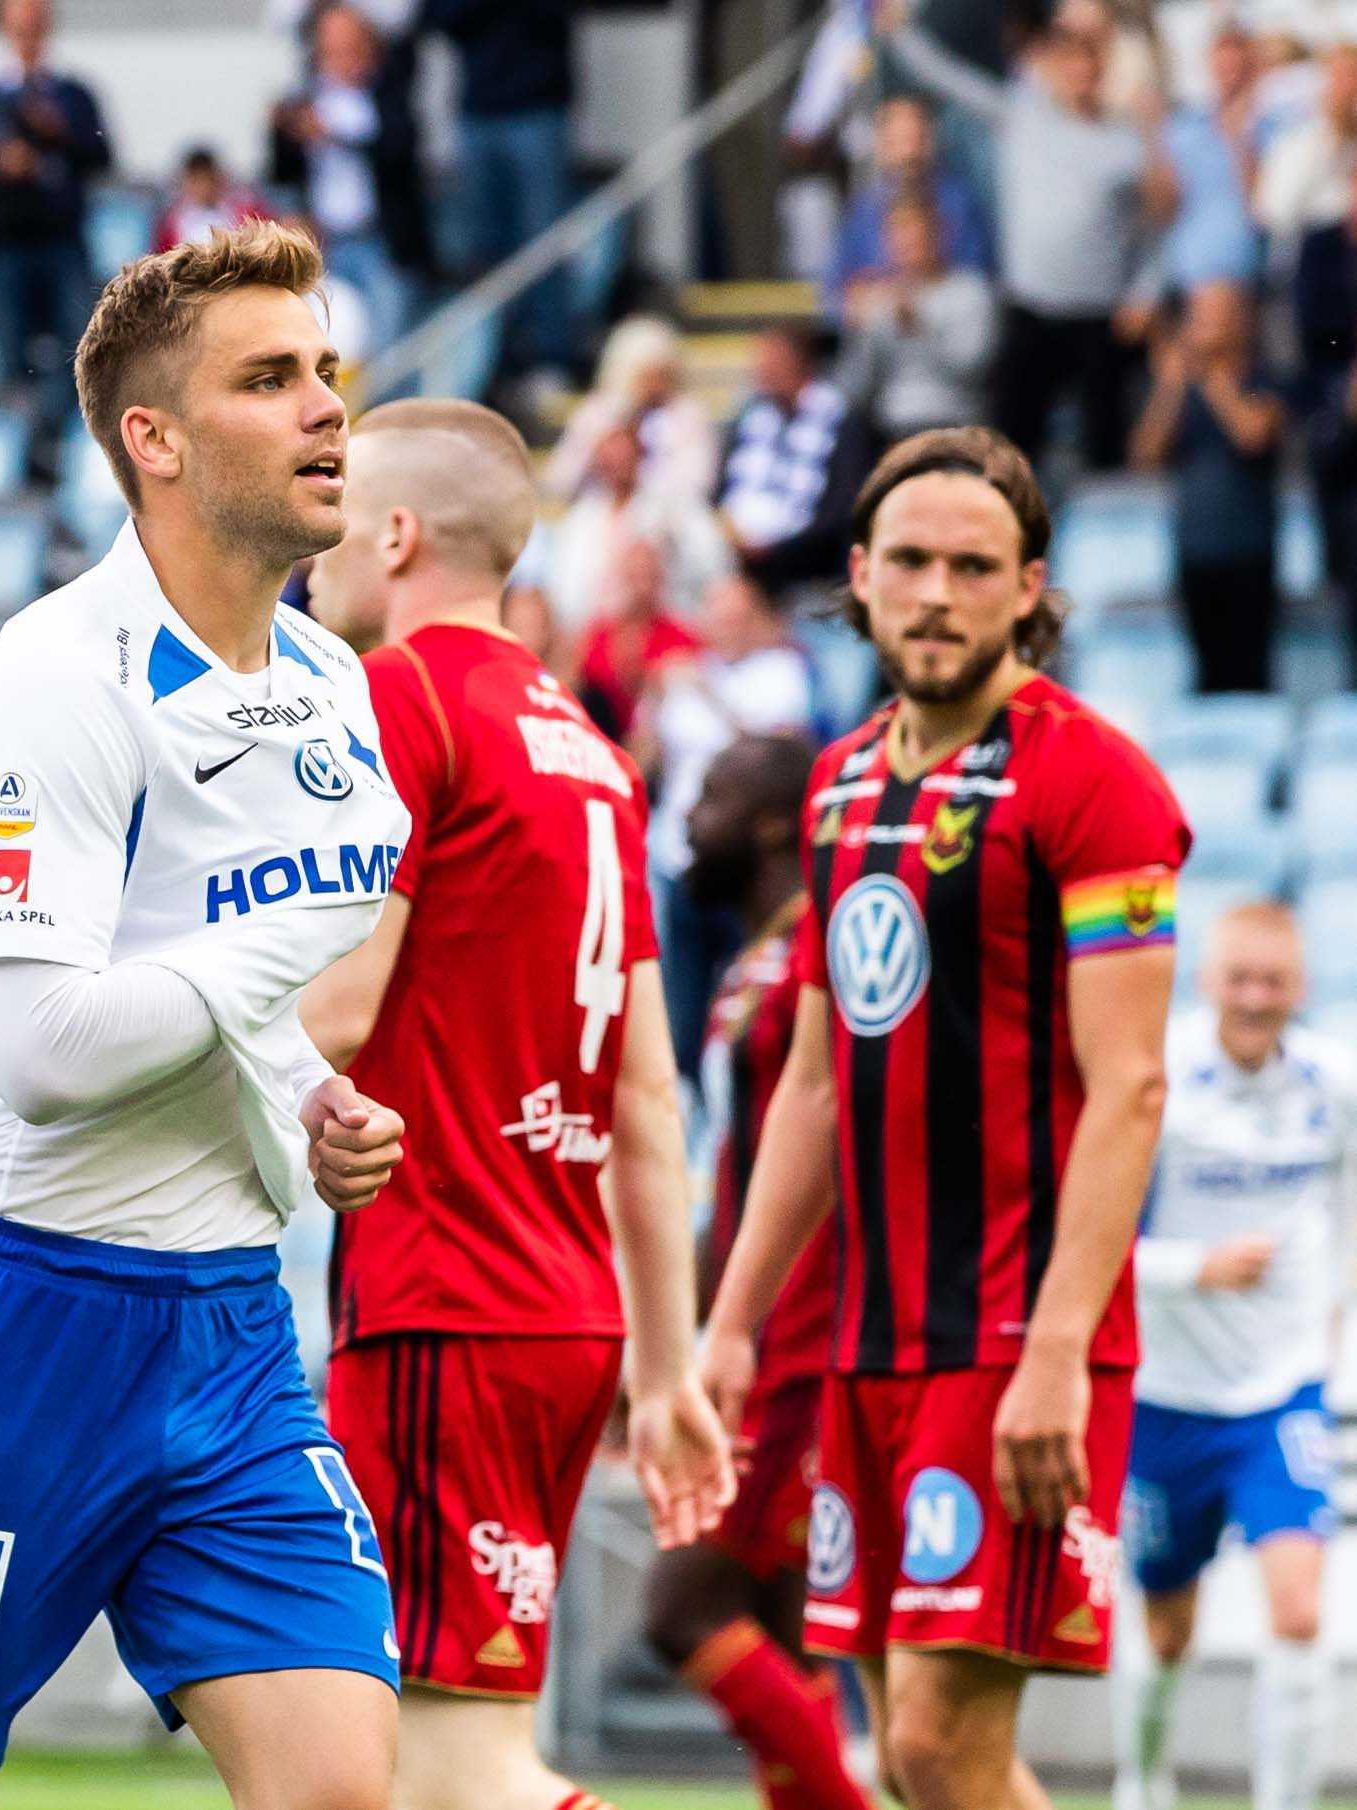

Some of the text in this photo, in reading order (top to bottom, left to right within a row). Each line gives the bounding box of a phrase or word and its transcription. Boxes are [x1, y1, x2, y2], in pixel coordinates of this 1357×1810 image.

[19, 910, 55, 926] SPEL
[573, 798, 626, 1075] 4
[905, 1493, 958, 1557] N
